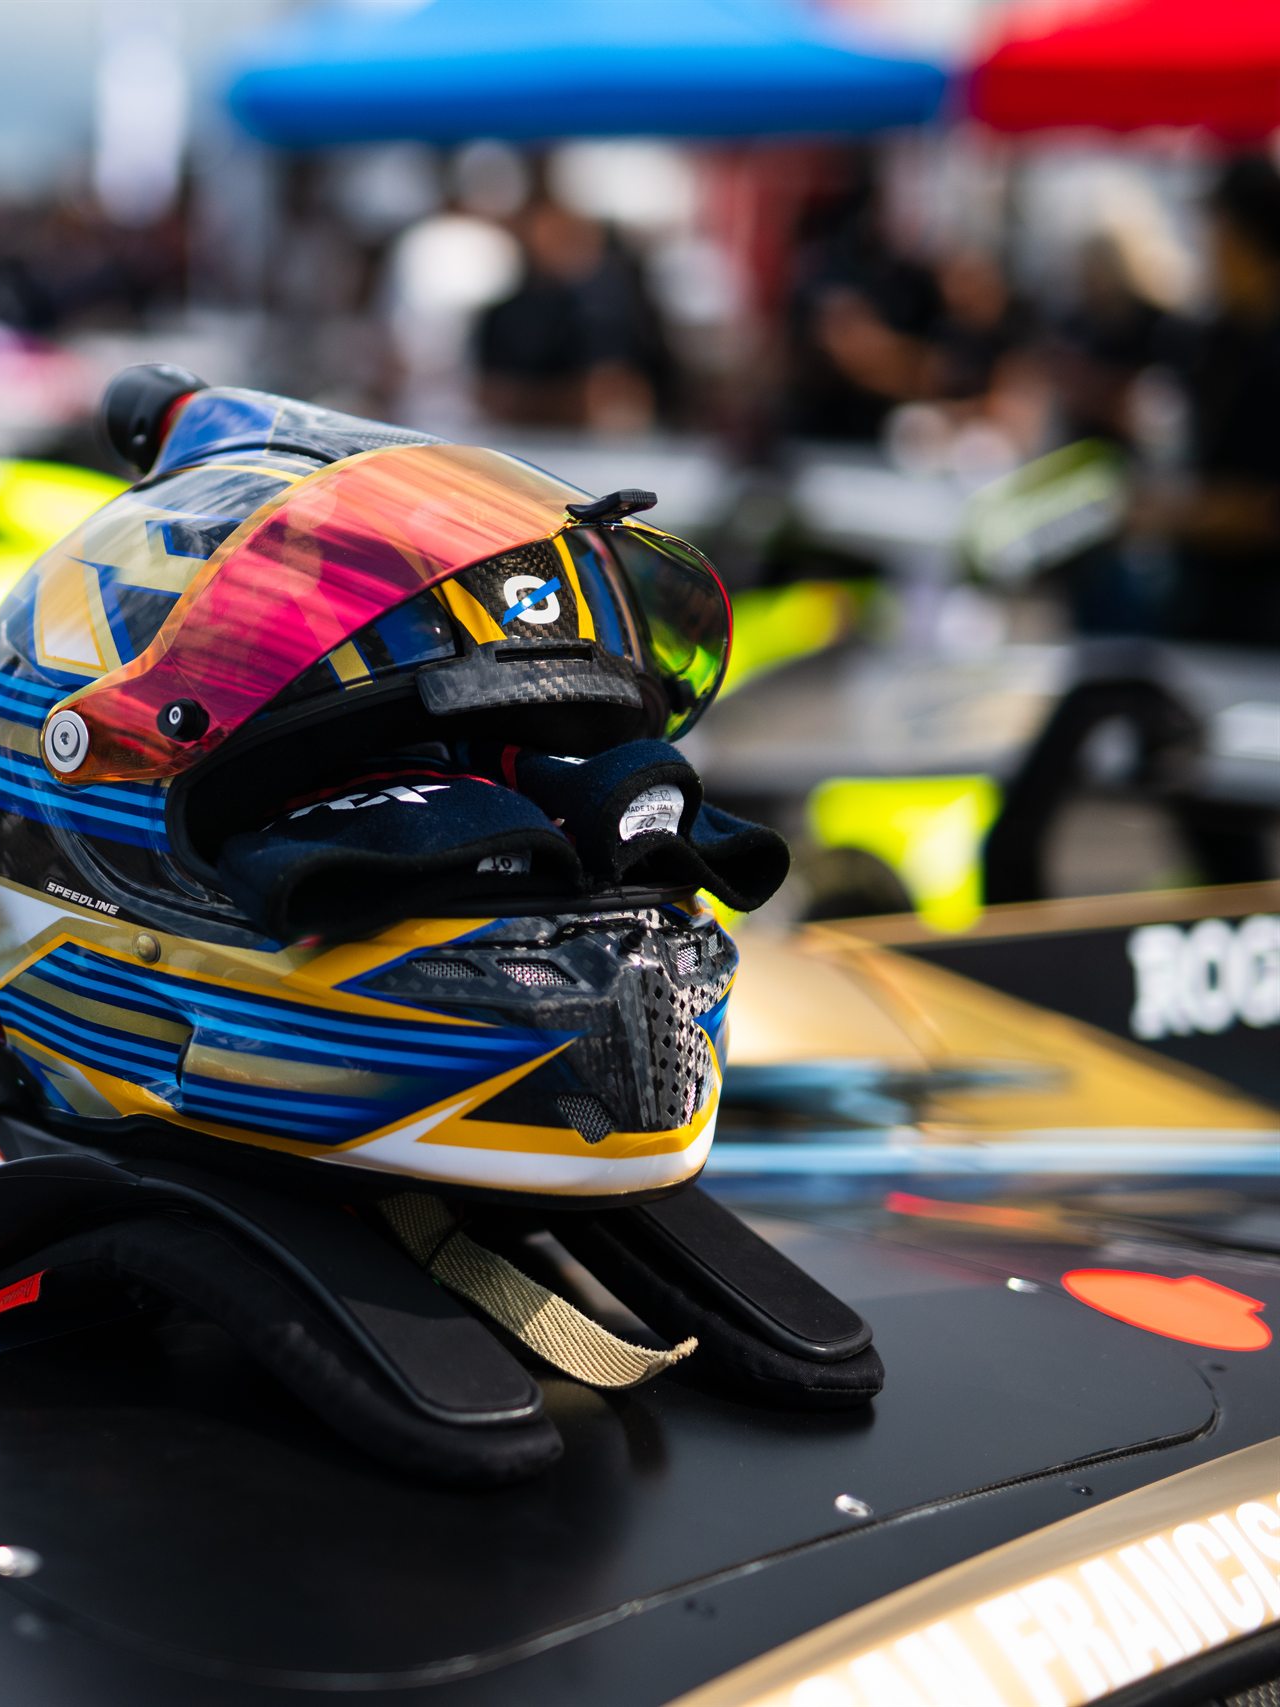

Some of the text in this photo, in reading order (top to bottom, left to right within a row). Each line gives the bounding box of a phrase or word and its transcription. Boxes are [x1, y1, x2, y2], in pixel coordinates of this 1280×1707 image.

[647, 804, 655, 812] IN
[636, 816, 657, 830] 10
[46, 881, 120, 915] SPEEDLINE
